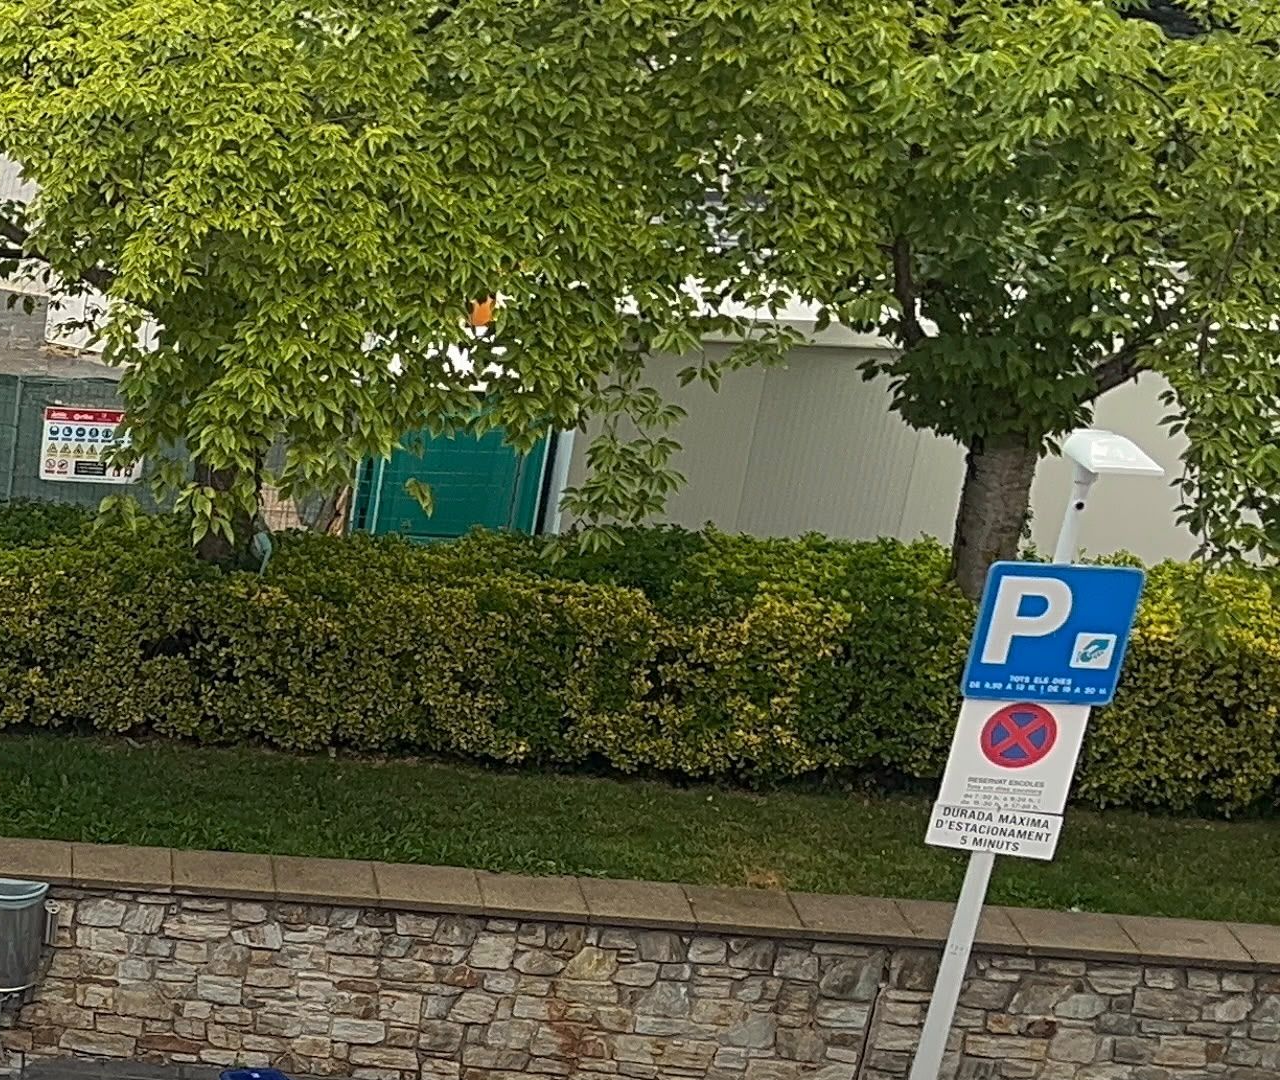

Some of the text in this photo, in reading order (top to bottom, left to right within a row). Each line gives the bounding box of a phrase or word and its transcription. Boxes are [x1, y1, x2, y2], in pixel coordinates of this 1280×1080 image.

[981, 575, 1073, 665] P
[943, 807, 993, 822] DURADA
[936, 819, 1052, 842] D'ESTACIONAMENT
[960, 835, 1020, 851] 5 MINUTS
